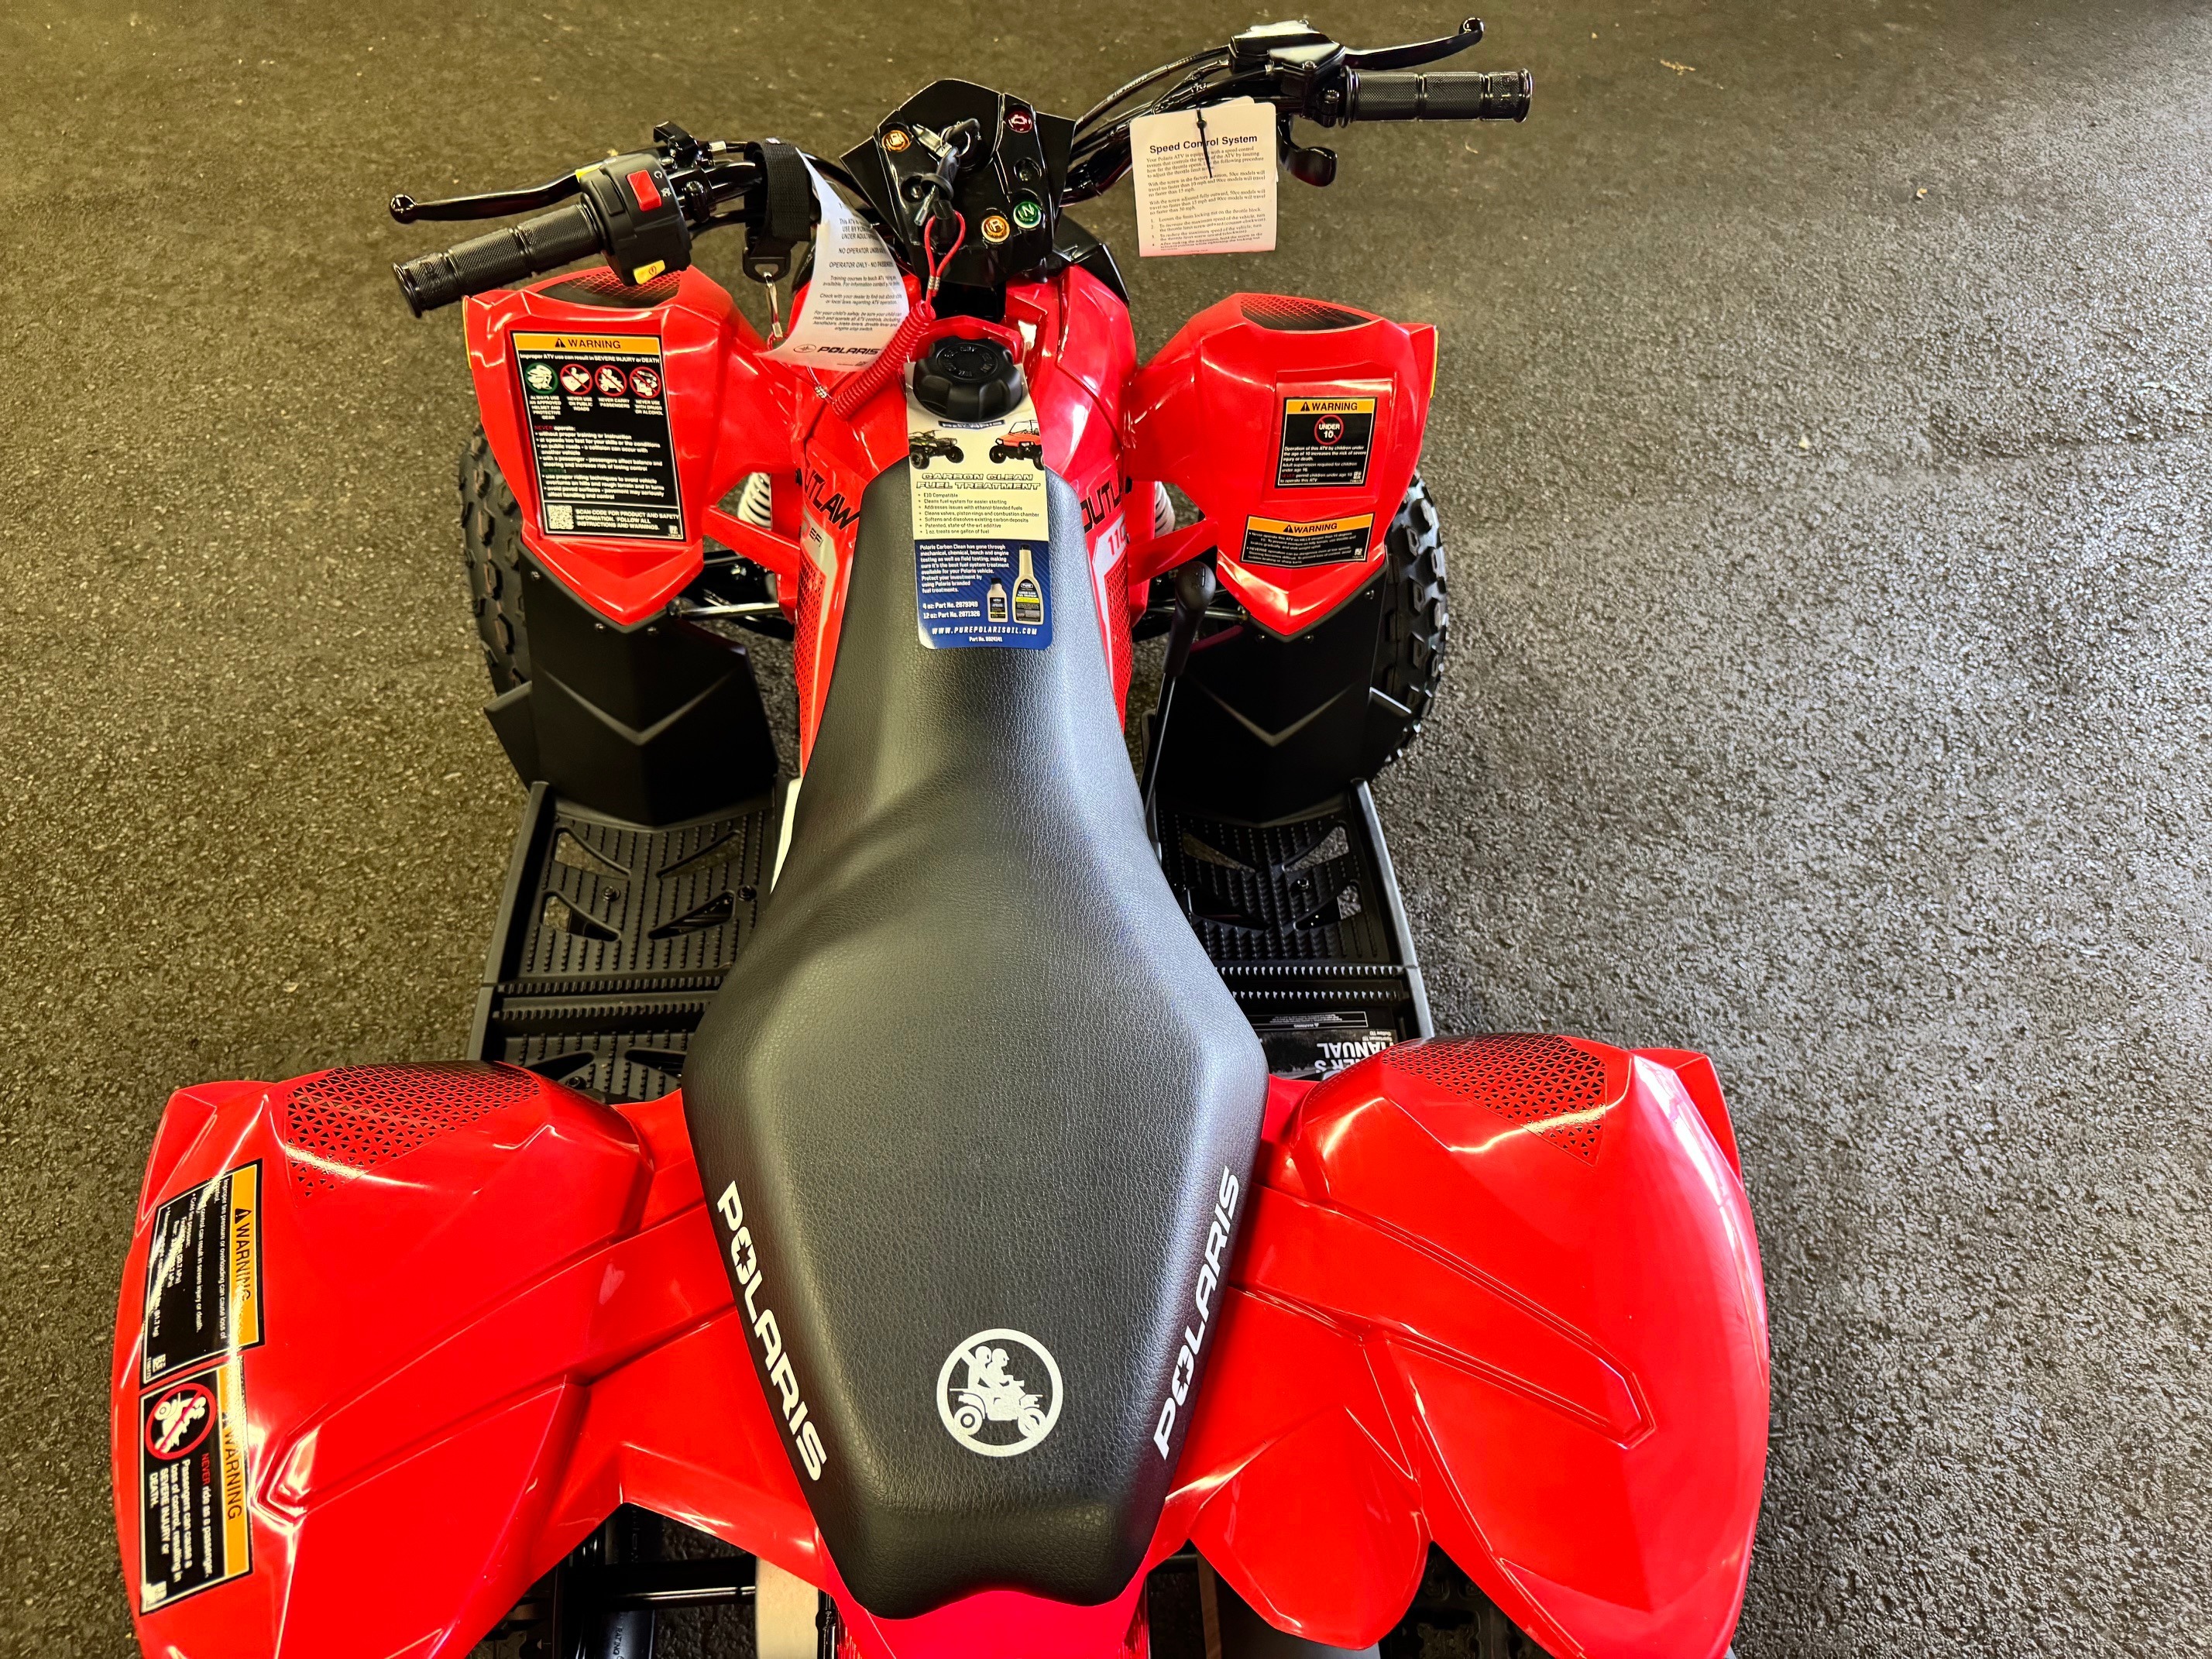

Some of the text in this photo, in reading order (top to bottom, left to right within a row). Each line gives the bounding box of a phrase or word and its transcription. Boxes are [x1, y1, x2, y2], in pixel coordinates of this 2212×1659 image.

[1150, 136, 1257, 154] Speed Conrol System
[568, 339, 620, 349] WARNING
[809, 527, 823, 548] EFI
[1108, 524, 1126, 556] 110
[1293, 524, 1337, 534] WARNING
[932, 627, 1037, 635] WWW.PUREPOLARISOIL.COM
[1153, 1165, 1239, 1461] POLARIS
[717, 1180, 827, 1481] POLARIS
[201, 1452, 211, 1486] NEVER
[224, 1429, 243, 1520] WARNING
[160, 1467, 170, 1555] SEVERE INJURY or
[202, 1486, 211, 1505] ride
[203, 1505, 211, 1518] as
[170, 1463, 184, 1583] loss of control, resulting in
[180, 1458, 193, 1569] Passengers can cause a
[202, 1526, 212, 1578] passenger.
